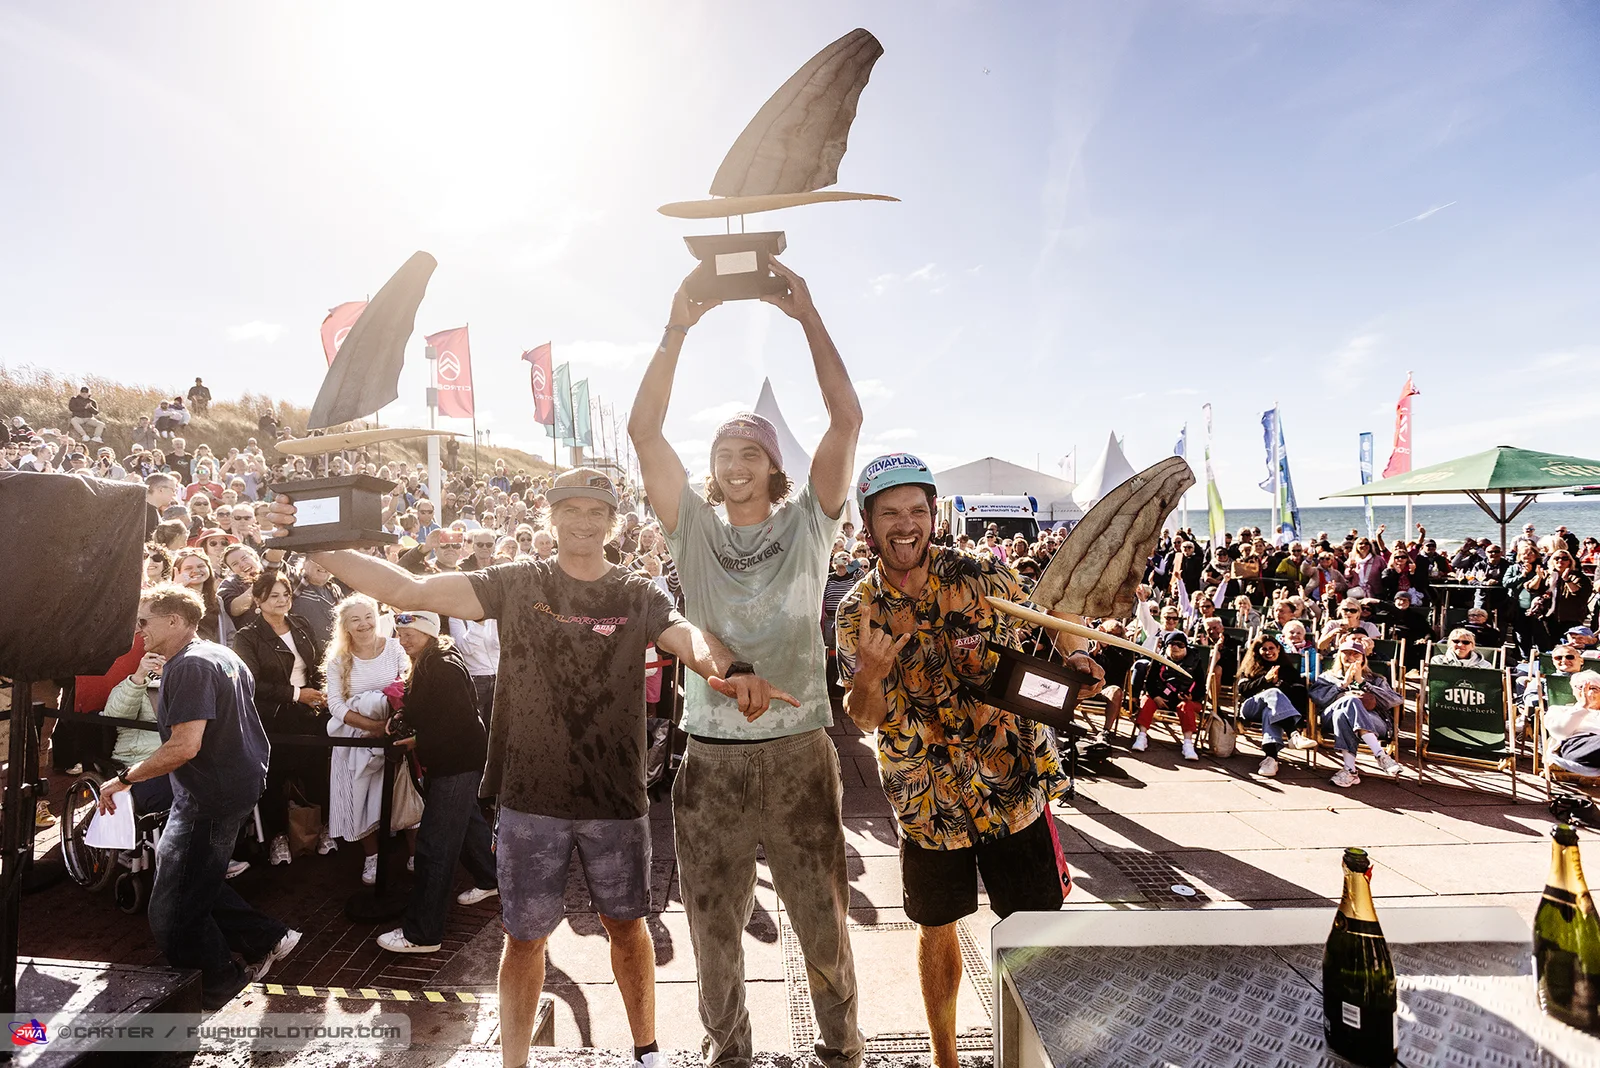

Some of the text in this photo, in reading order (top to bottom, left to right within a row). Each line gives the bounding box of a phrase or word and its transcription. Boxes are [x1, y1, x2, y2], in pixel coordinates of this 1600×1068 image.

[867, 457, 925, 477] SILVAPLANA
[1444, 688, 1486, 706] JEVER
[1435, 702, 1498, 715] Friesisch-herb.
